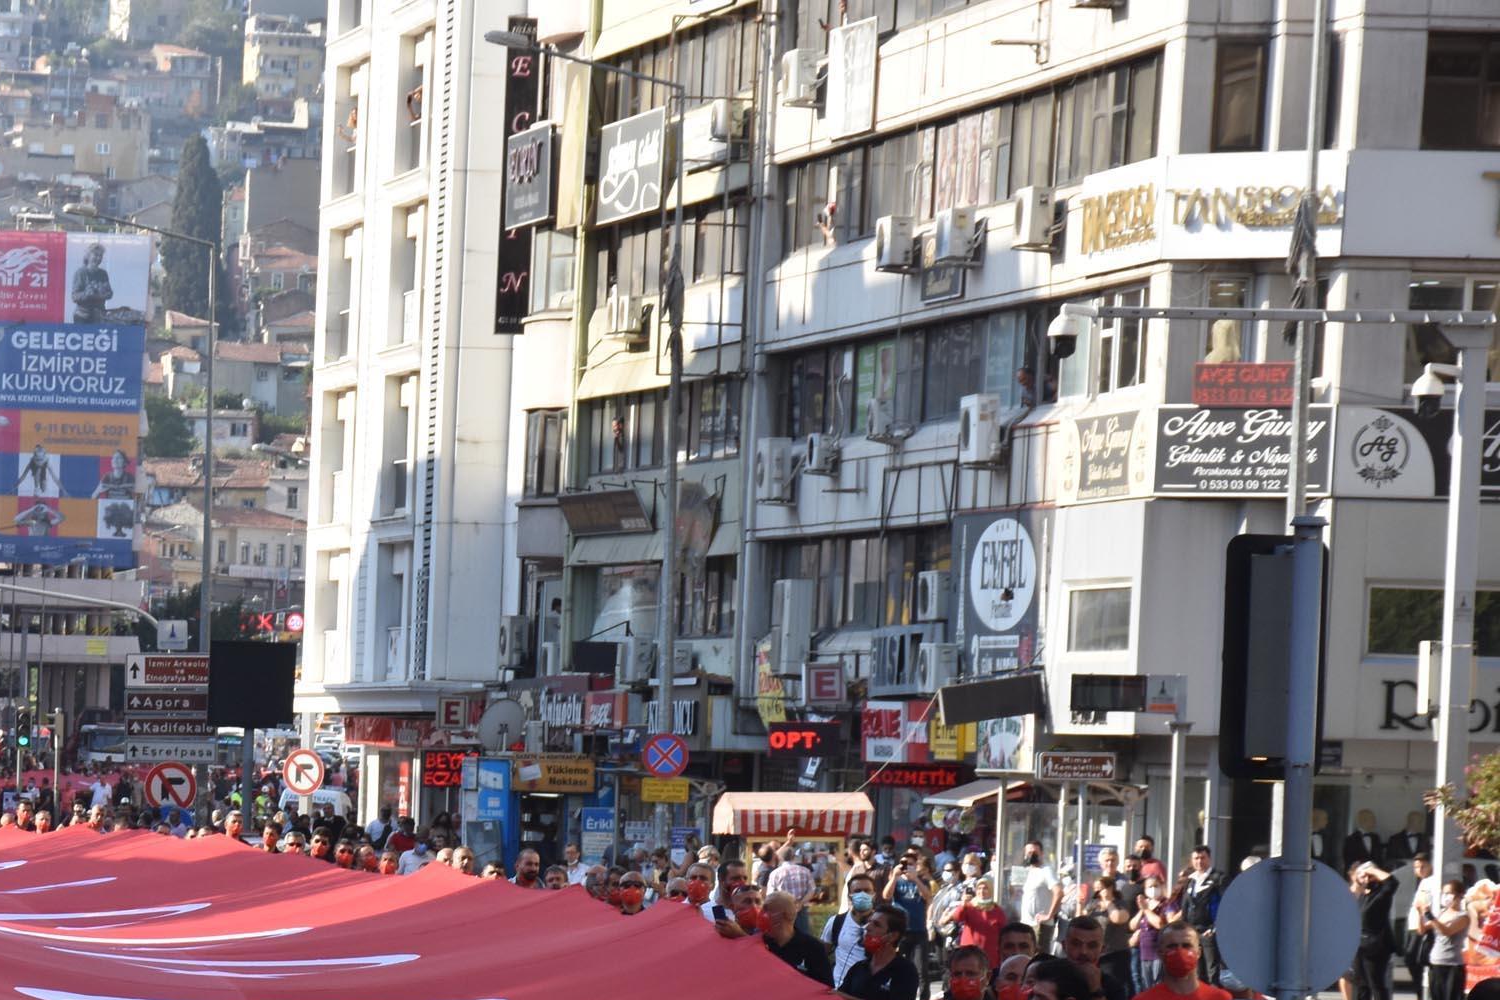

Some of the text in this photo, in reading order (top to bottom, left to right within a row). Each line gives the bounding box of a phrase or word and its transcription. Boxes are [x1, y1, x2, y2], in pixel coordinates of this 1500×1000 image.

[11, 329, 118, 351] GELECEĞİ
[21, 351, 107, 374] İZMİR'DE
[2, 373, 126, 394] KURUYORUZ
[18, 393, 54, 404] KENTLERİ
[90, 397, 137, 407] BULUŞUYOR
[61, 420, 98, 435] EYLÜL
[102, 425, 129, 436] 2021
[1164, 409, 1326, 442] Ayşe Güny
[1165, 446, 1226, 467] Gelinlik
[1231, 449, 1244, 462] &
[1193, 466, 1241, 476] Perakende
[1254, 467, 1287, 478] Toptan
[1209, 480, 1228, 489] 533
[1230, 480, 1244, 489] 03
[1246, 480, 1260, 489] 09
[1263, 480, 1281, 489] 122
[148, 659, 209, 669] İzmir Arkeoloj
[188, 674, 208, 682] Müze
[815, 671, 837, 697] E
[143, 696, 190, 709] Agora
[445, 701, 461, 725] E
[143, 721, 214, 734] Kadifekale
[142, 746, 213, 758] Eşrefpaşa
[547, 765, 589, 775] Yükleme
[869, 766, 958, 786] KOZMETİK
[424, 772, 462, 785] ECZA
[549, 777, 588, 786] Noktası
[586, 817, 613, 830] Erikl
